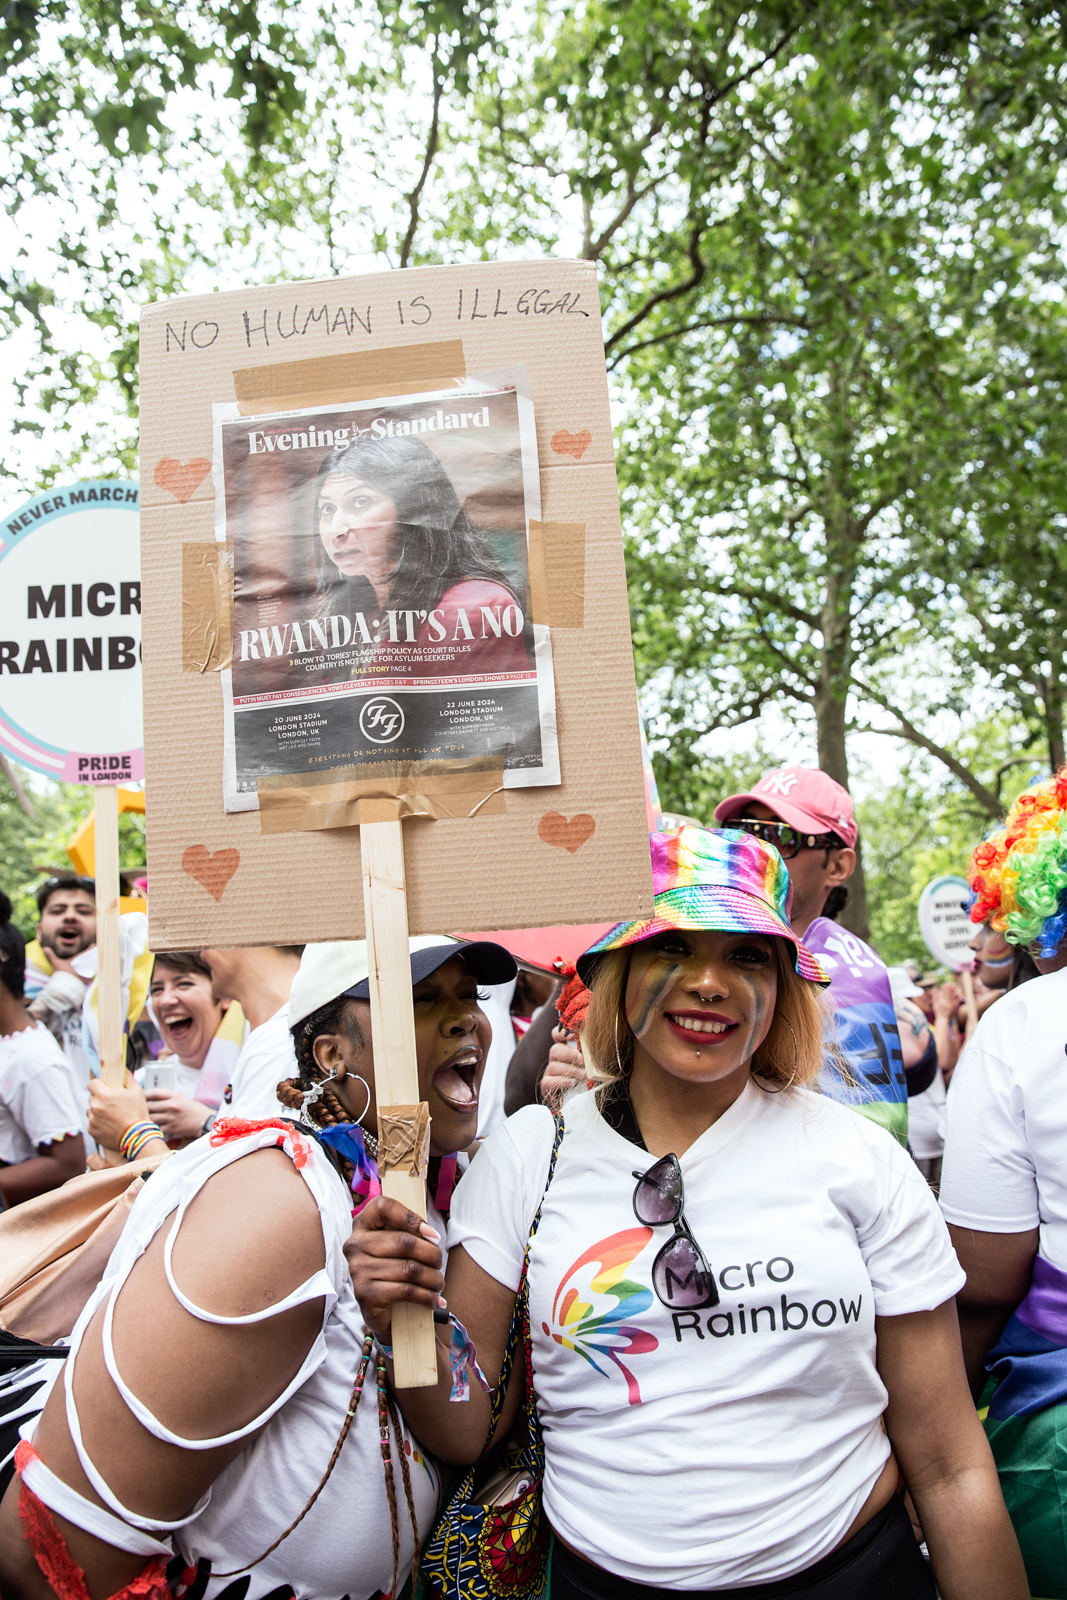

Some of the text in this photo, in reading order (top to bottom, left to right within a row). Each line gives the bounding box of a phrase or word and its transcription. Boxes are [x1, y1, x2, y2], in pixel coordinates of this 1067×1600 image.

[166, 320, 219, 352] NO
[242, 304, 372, 348] HUMAN
[398, 295, 432, 325] IS
[248, 406, 491, 455] Evening Standard
[7, 488, 138, 535] NEVER MARCH
[239, 604, 524, 662] RWANDA: IT'S A NO
[0, 636, 142, 674] RAINB
[294, 657, 314, 666] BLOW
[314, 655, 324, 663] TO
[352, 648, 386, 657] FLAGSHIP
[305, 662, 338, 672] COUNTRY
[269, 719, 328, 732] LONDON STADIUM
[278, 730, 309, 738] LONDON,
[92, 772, 131, 780] LONDON
[308, 753, 351, 763] EVERYTHING
[664, 1256, 794, 1300] Mcro
[671, 1294, 862, 1342] Rainbow
